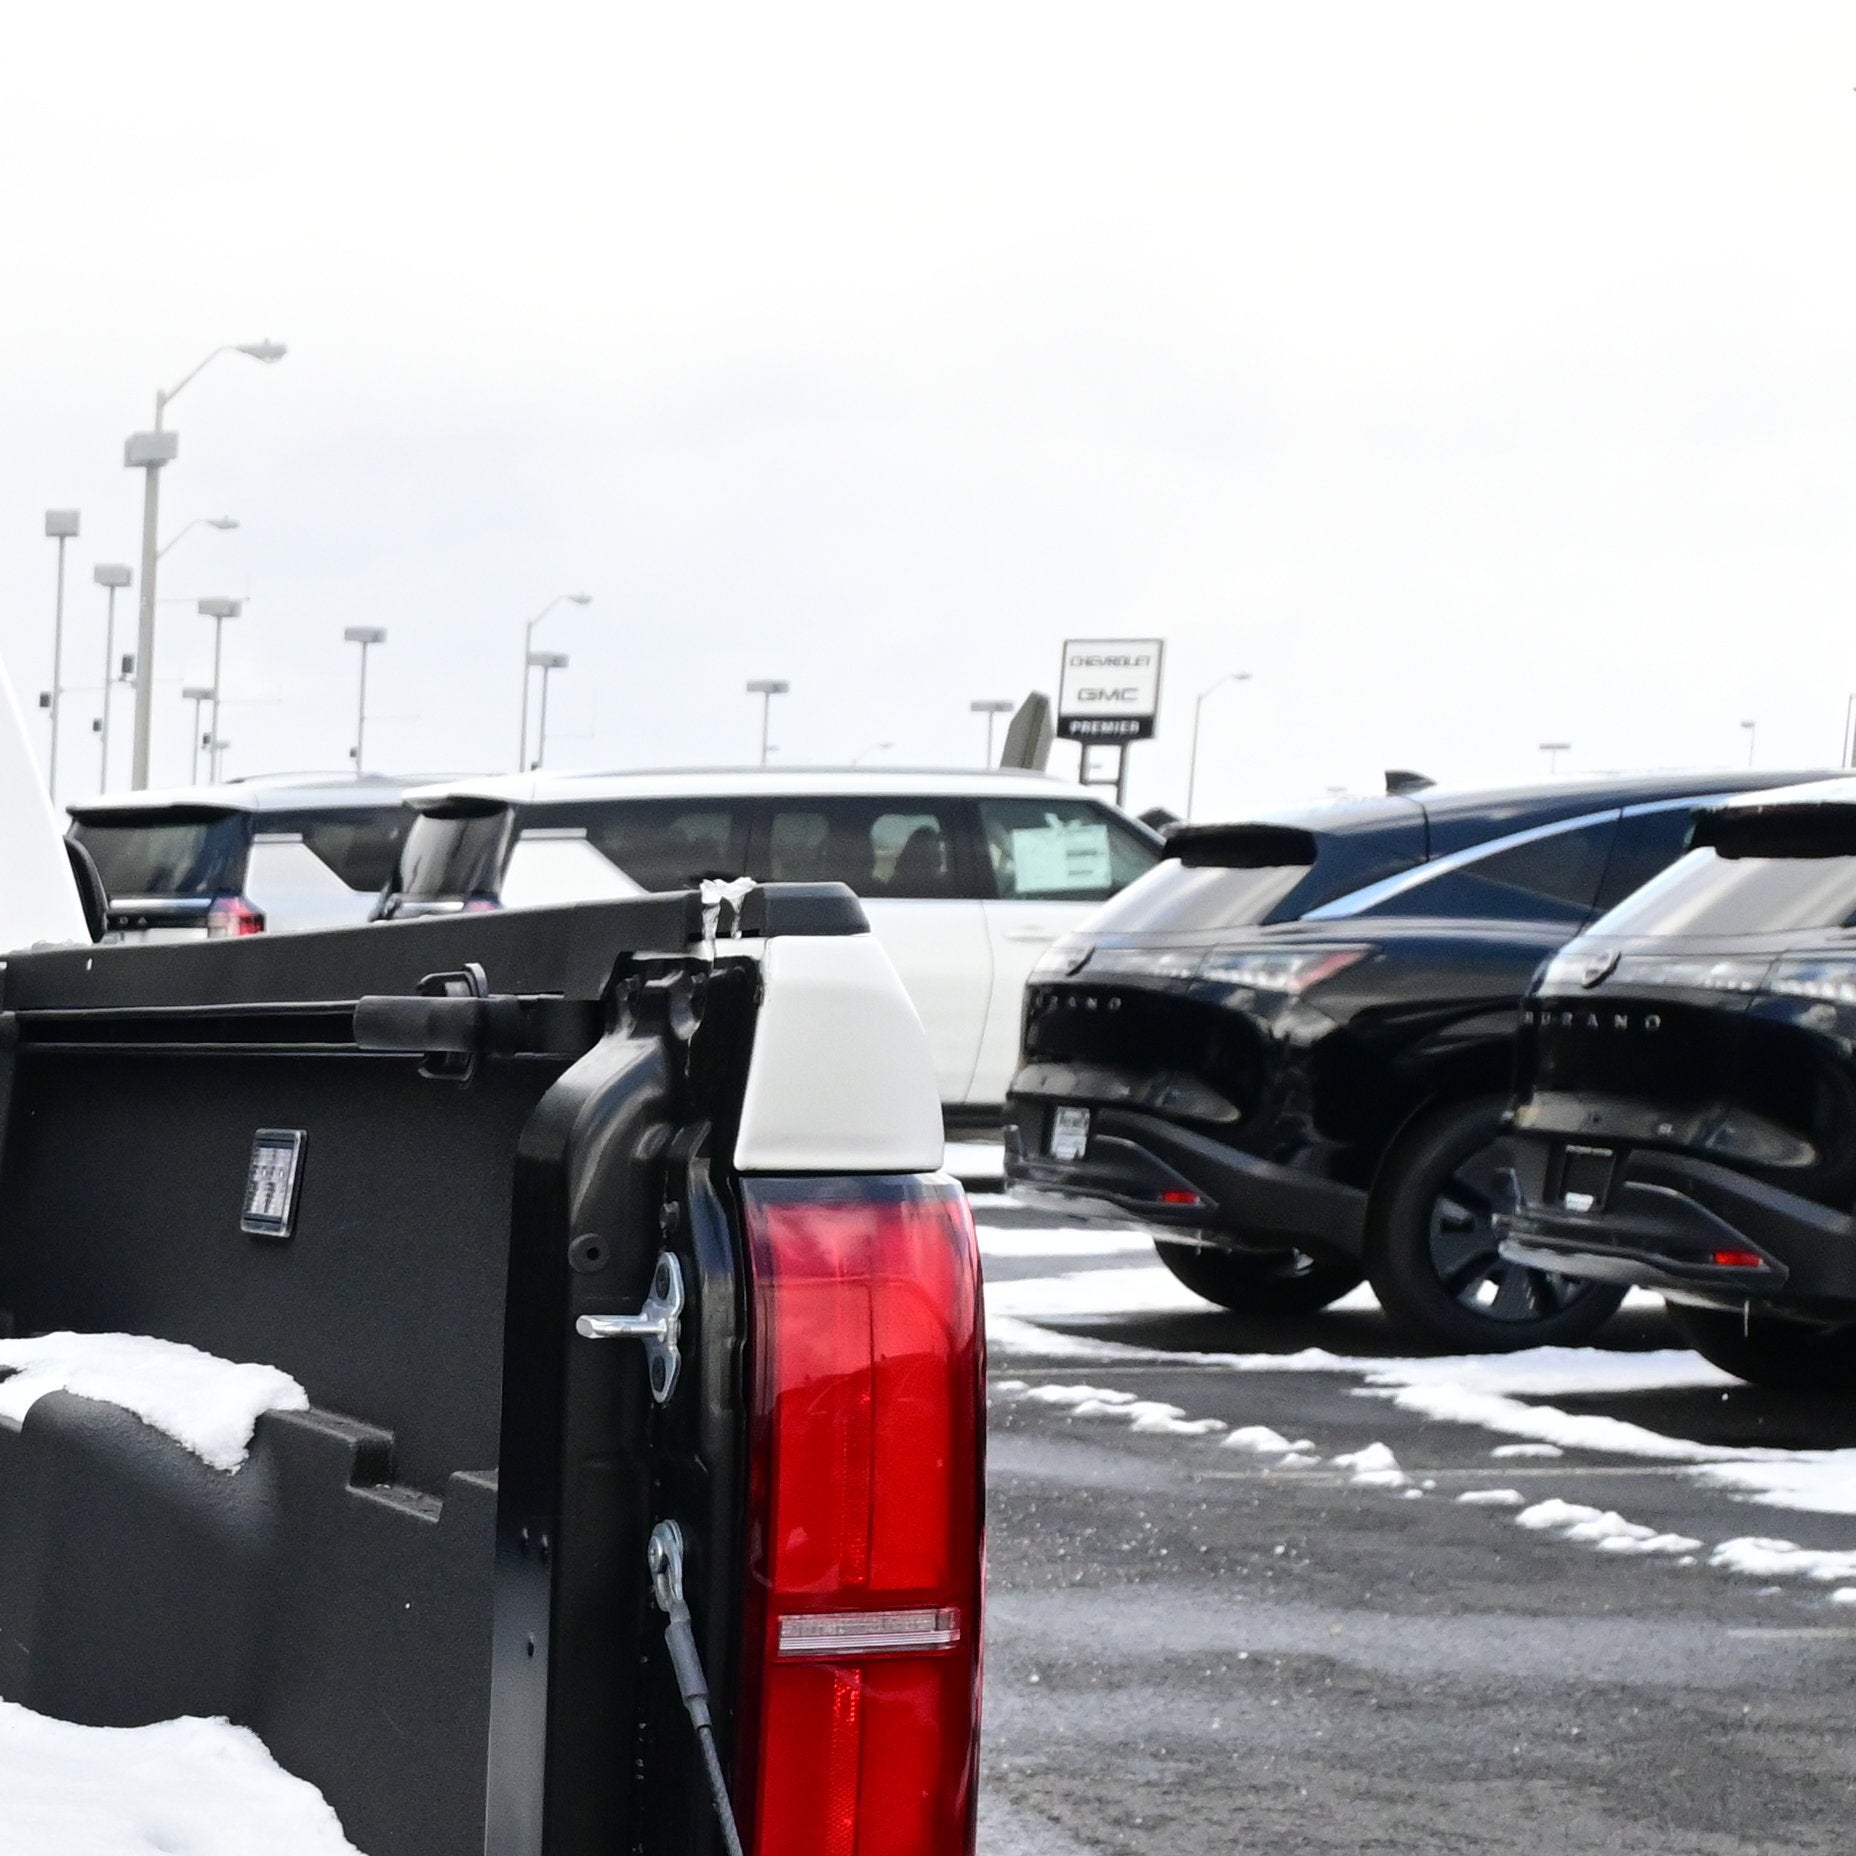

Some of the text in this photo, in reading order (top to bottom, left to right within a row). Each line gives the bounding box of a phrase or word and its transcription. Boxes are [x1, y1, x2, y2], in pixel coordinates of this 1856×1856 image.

[1070, 655, 1151, 667] CHEVROLET
[1077, 688, 1139, 701] GMC
[1070, 720, 1140, 735] PREMIER
